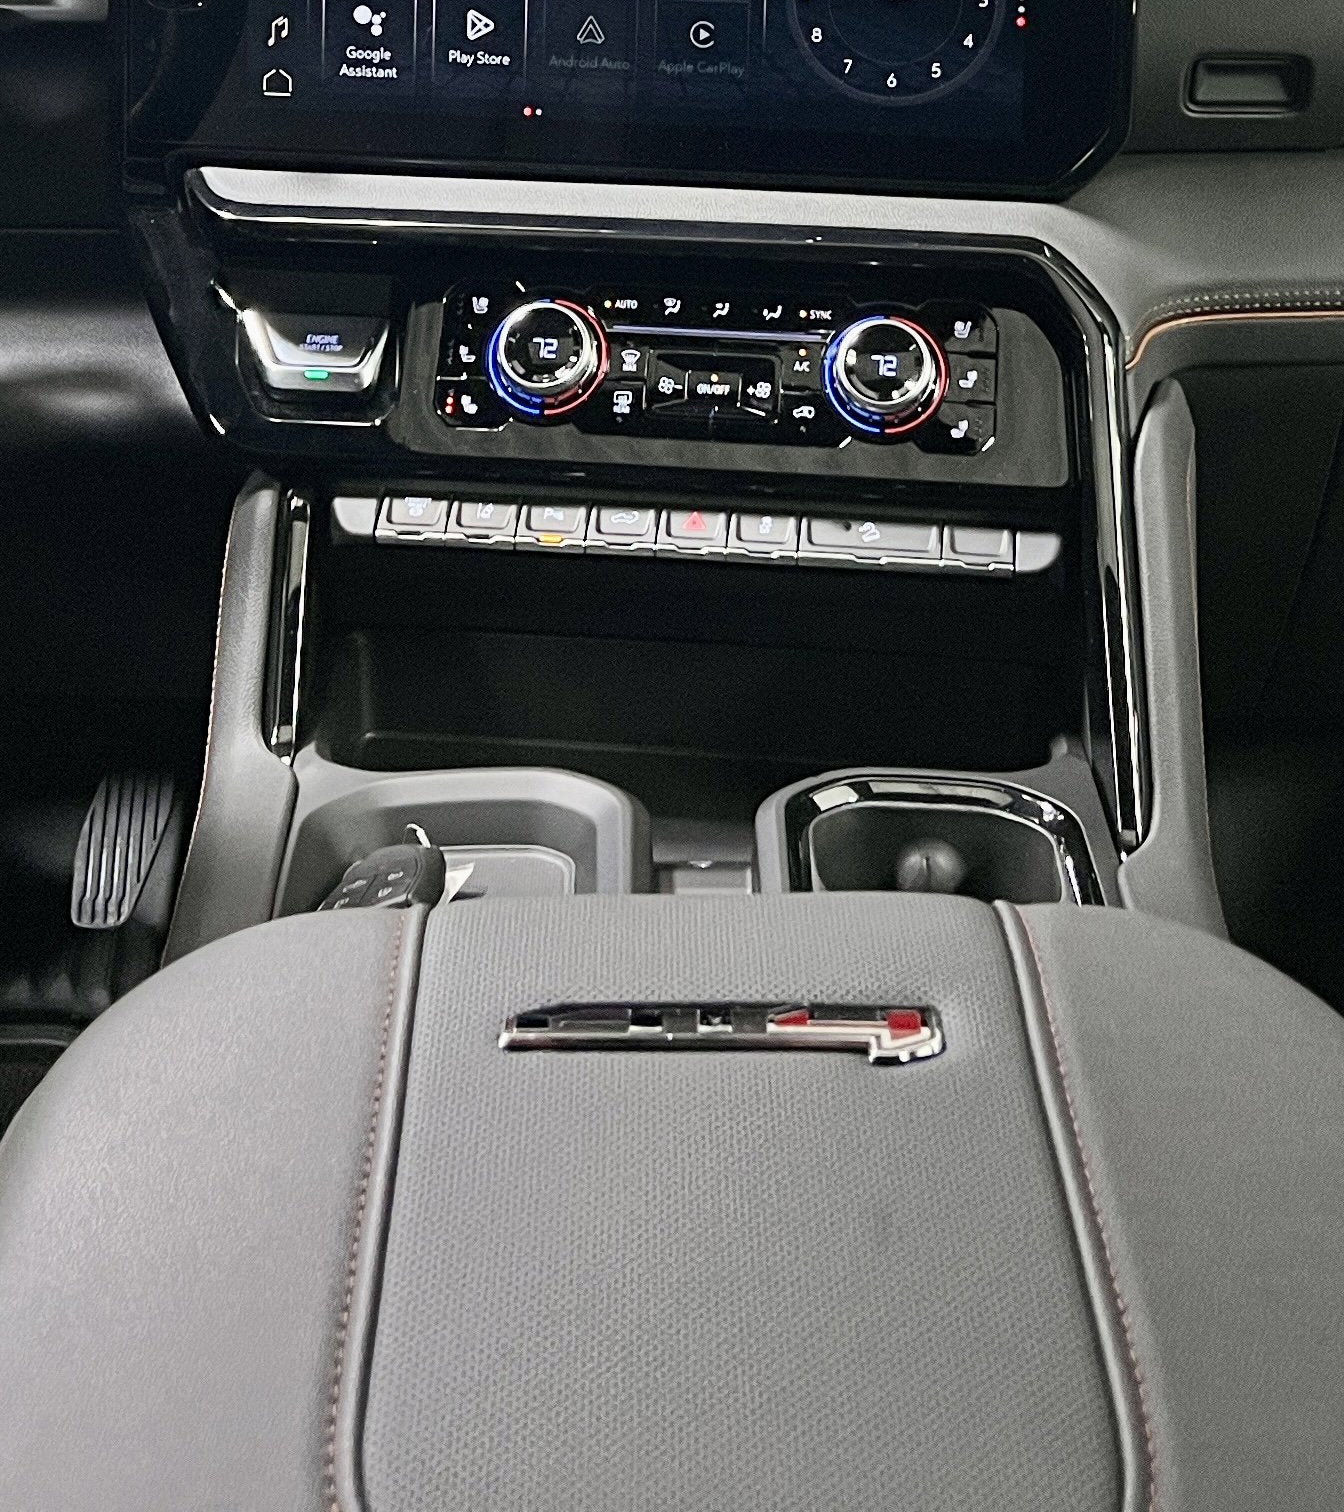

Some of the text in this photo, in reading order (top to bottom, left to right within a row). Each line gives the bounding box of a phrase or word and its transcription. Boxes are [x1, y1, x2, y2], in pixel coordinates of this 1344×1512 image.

[811, 28, 822, 43] 8
[963, 33, 974, 48] 4
[345, 45, 392, 63] Google
[448, 50, 511, 67] Play Store
[549, 55, 631, 70] Android Auto
[658, 59, 745, 78] Apple CarPlay
[843, 59, 853, 74] 7
[931, 62, 942, 78] 5
[339, 64, 398, 79] Assistant
[886, 73, 897, 88] 6
[614, 299, 638, 310] AUTO
[809, 310, 832, 321] SYNC
[306, 334, 339, 345] ENGINE
[533, 338, 558, 359] 72
[793, 361, 810, 372] A/C
[870, 355, 897, 376] 72
